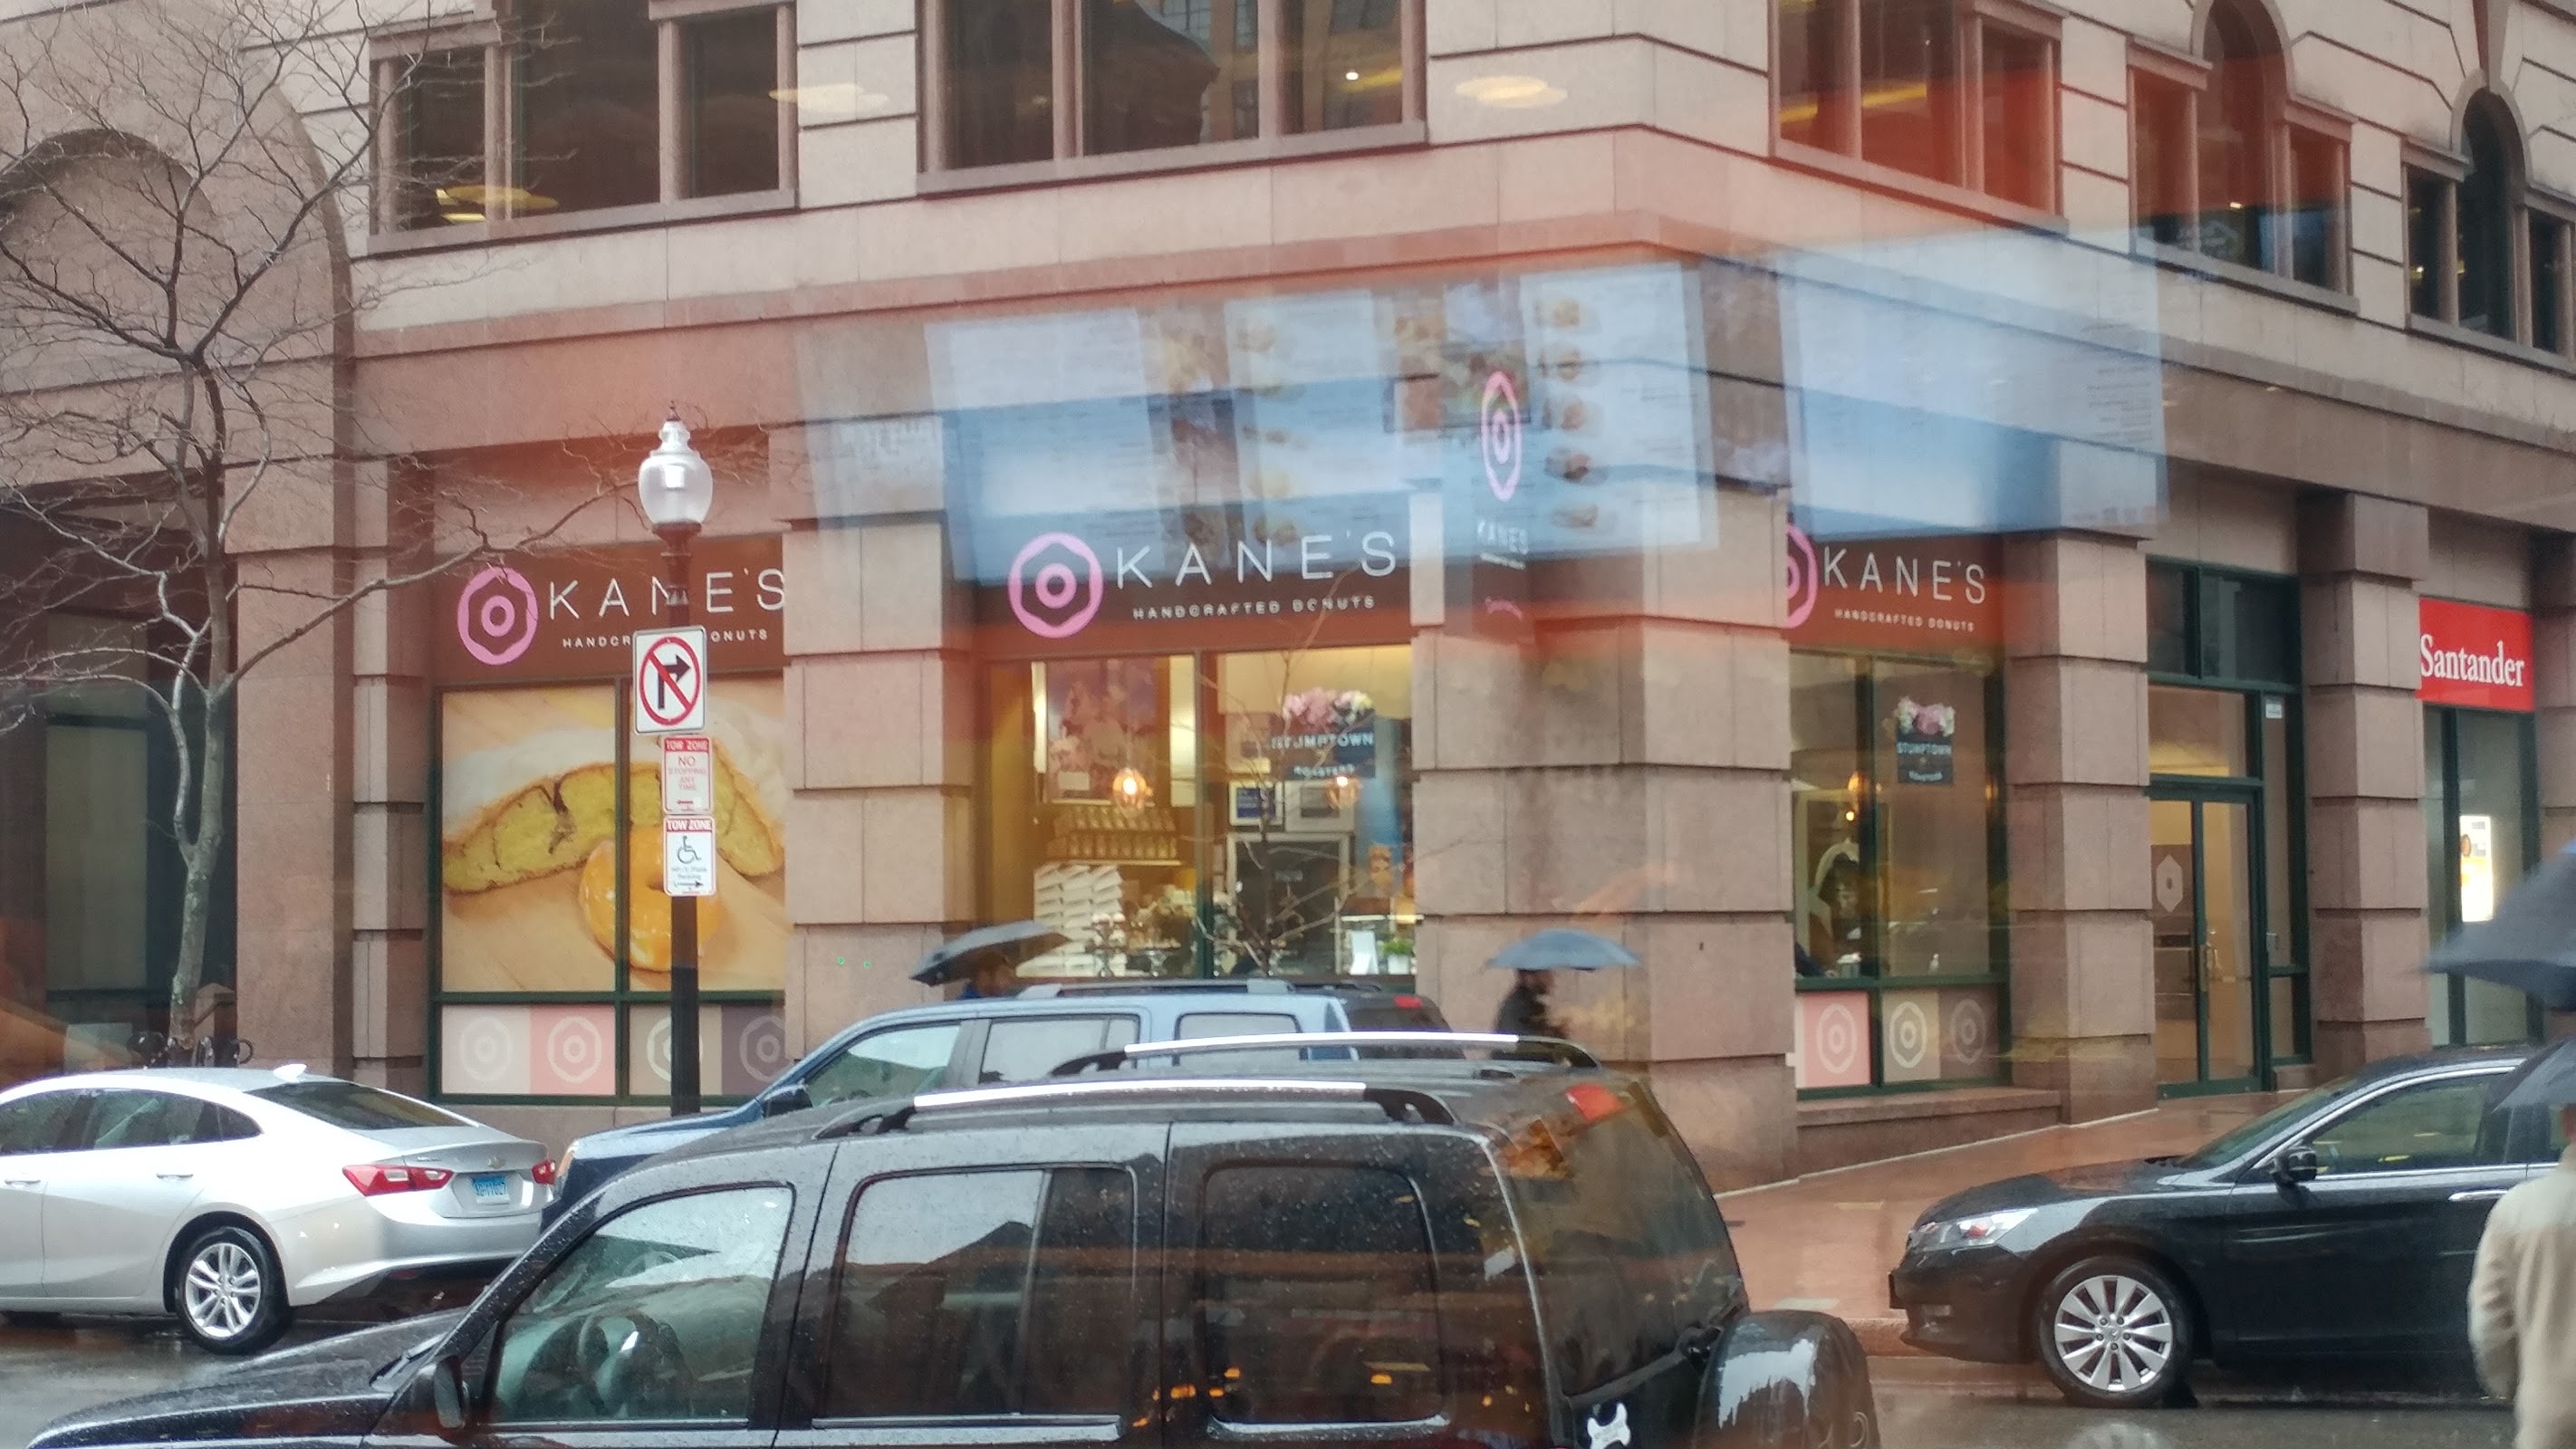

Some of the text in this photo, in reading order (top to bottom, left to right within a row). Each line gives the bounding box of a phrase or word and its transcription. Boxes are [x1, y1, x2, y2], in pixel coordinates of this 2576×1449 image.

[1117, 531, 1398, 590] KANE'S
[1823, 545, 1986, 604] KANE'S
[549, 568, 784, 620] KANE'S
[1132, 595, 1376, 620] HANDCRAFTED DONUTS
[710, 628, 769, 643] ONUTS
[2420, 633, 2525, 687] Santander
[666, 739, 709, 752] TOW ZONE
[678, 755, 696, 767] NO
[667, 819, 712, 831] TOW ZONE
